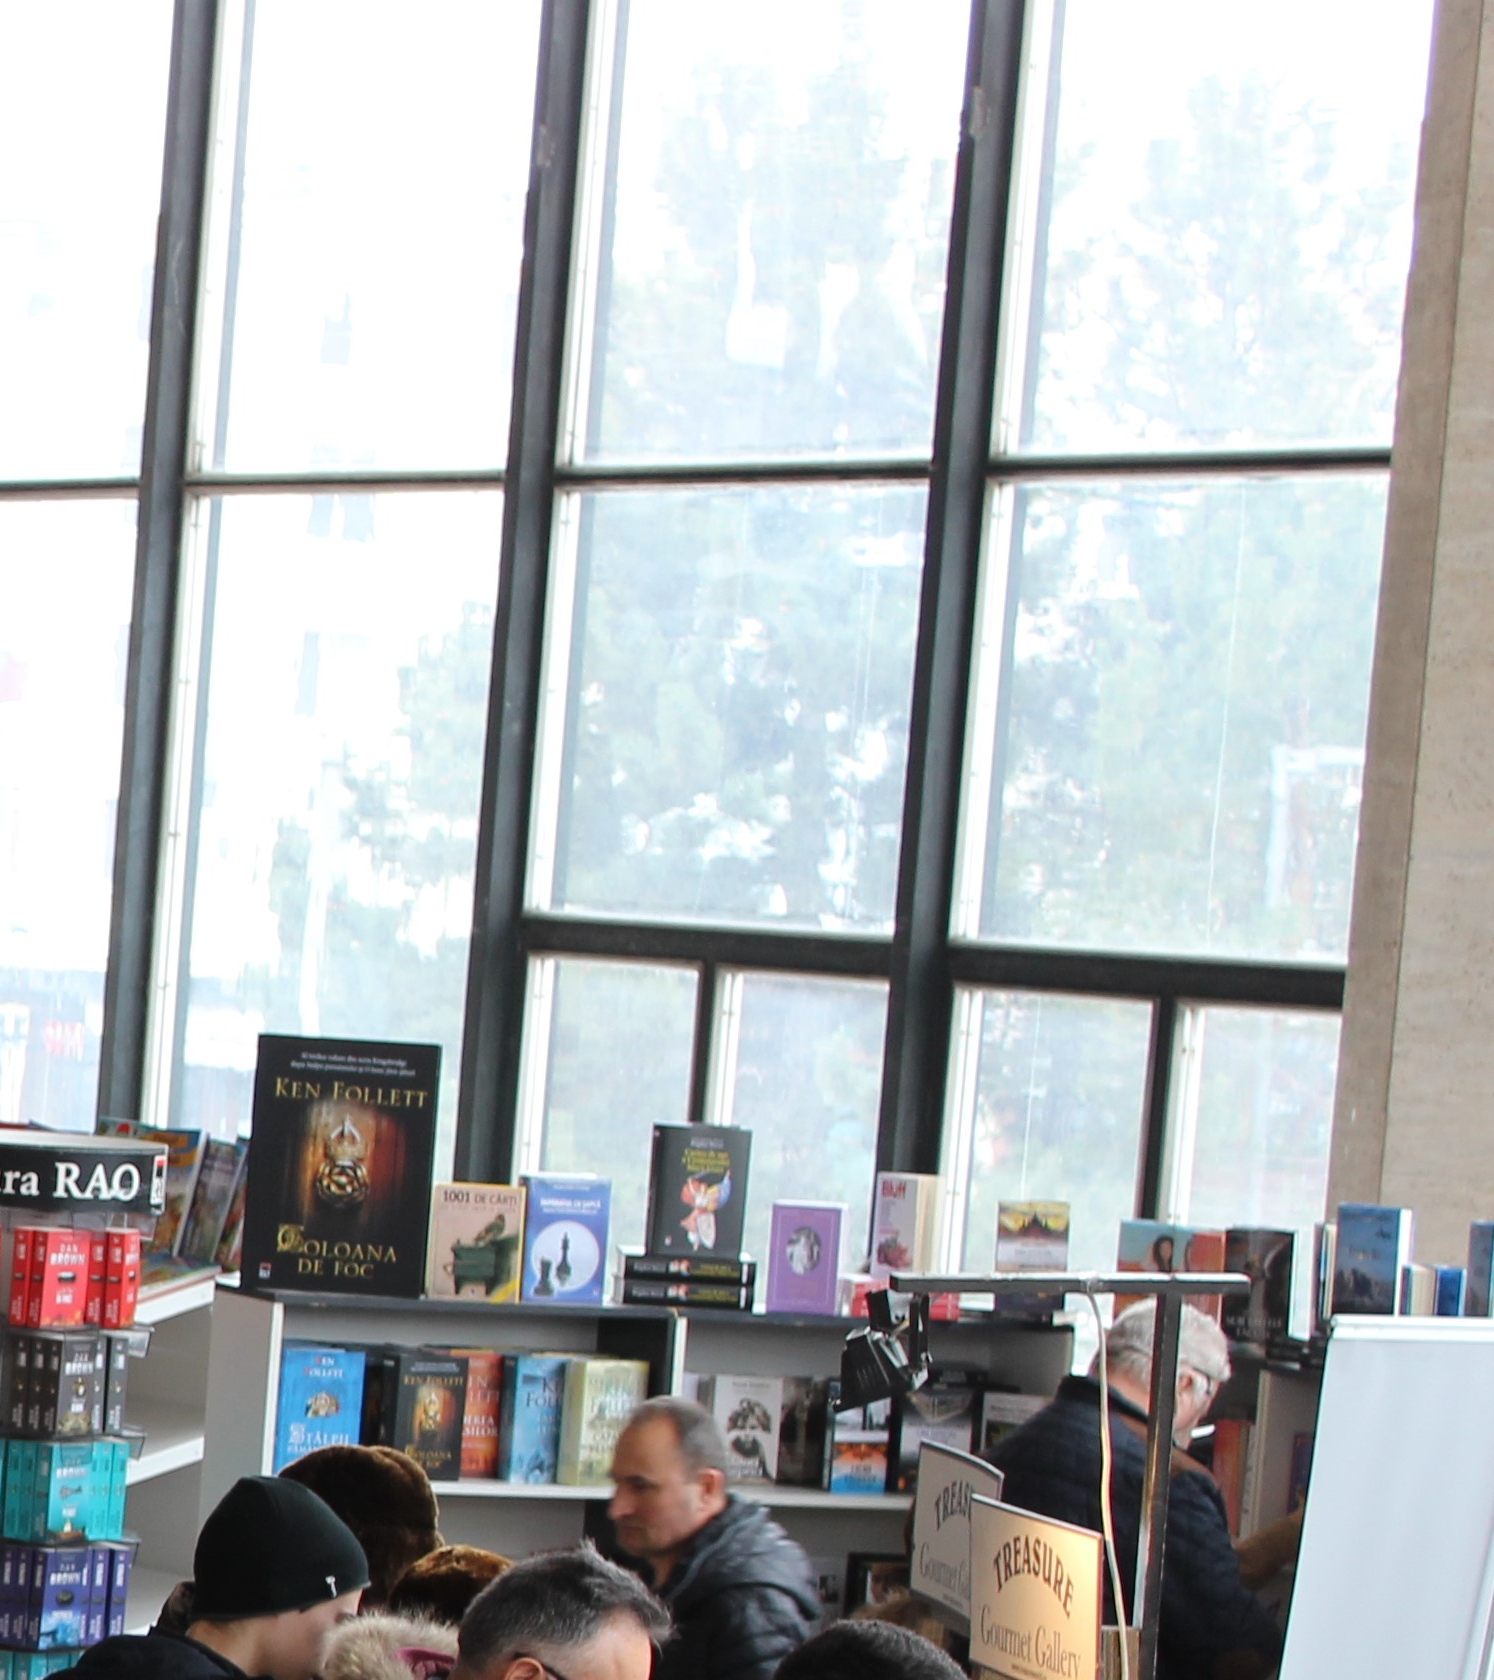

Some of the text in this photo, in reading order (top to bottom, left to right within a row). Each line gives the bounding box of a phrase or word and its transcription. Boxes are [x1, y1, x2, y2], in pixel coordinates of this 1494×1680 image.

[275, 1077, 429, 1108] KEN FOLLETT
[52, 1161, 141, 1201] RAO
[443, 1189, 470, 1203] 1001
[50, 1253, 86, 1266] BROWN
[59, 1243, 79, 1254] DAN
[277, 1223, 397, 1264] COLOANA
[298, 1257, 375, 1278] DE FOC
[934, 1480, 972, 1532] TREAS
[49, 1571, 81, 1585] BROWN
[919, 1542, 958, 1594] Gourmet
[993, 1534, 1074, 1620] TREASURE
[980, 1603, 1033, 1663] Gourmet
